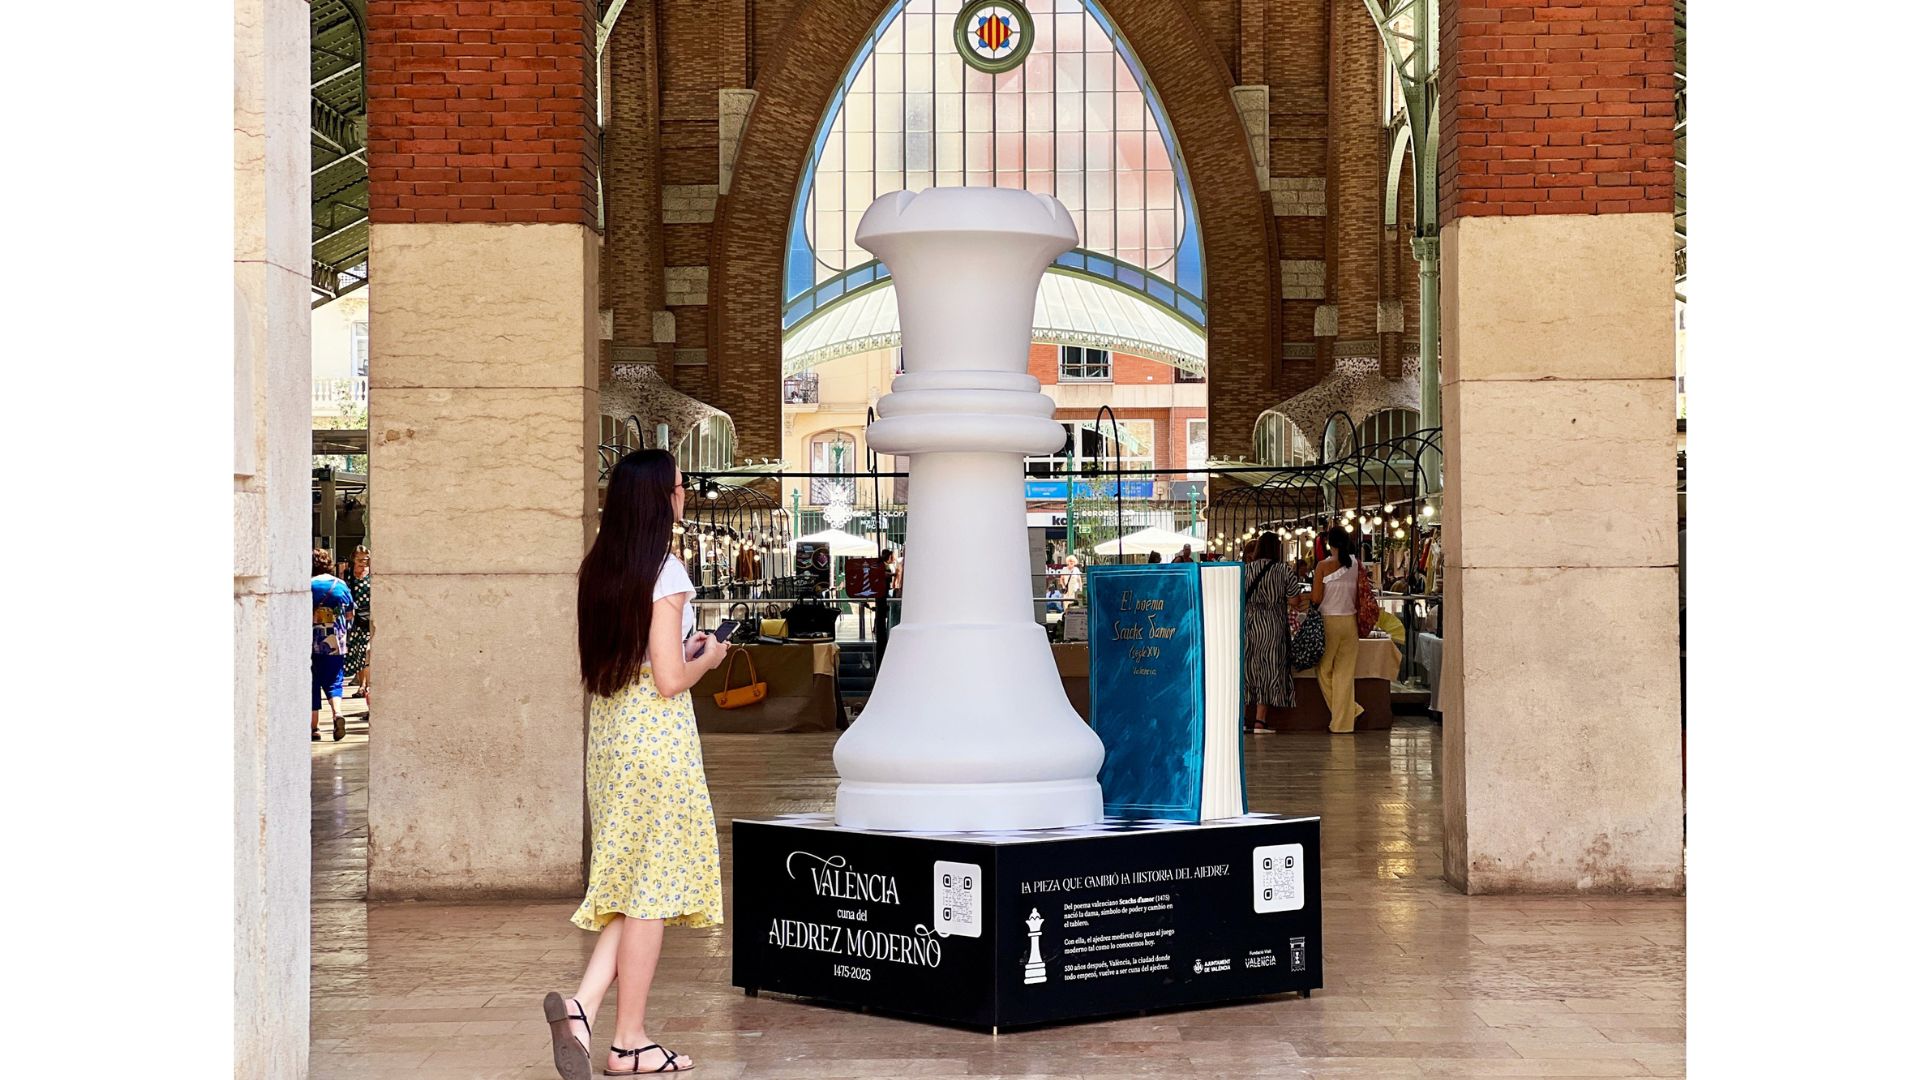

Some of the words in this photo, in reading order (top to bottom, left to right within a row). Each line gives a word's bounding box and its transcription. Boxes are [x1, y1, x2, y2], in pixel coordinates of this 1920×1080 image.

[1121, 591, 1132, 611] El
[1135, 599, 1164, 613] poema
[787, 851, 900, 904] VALÈNCIA
[1022, 882, 1031, 893] LA
[1034, 880, 1060, 892] PIEZA
[1063, 877, 1082, 891] QUE
[1122, 873, 1130, 884] LA
[1133, 869, 1173, 883] HISTORIA
[1176, 868, 1192, 879] DEL
[1194, 865, 1229, 878] AJEDREZ
[837, 909, 855, 919] cuna
[857, 909, 867, 921] del
[1074, 903, 1091, 912] poema
[1129, 906, 1143, 914] poder
[769, 919, 842, 953] AJEDREZ
[847, 924, 951, 968] MODERNO
[1093, 935, 1111, 944] ajedrez
[1112, 932, 1134, 940] medieval
[1161, 929, 1175, 937] juego
[1204, 959, 1230, 967] AJUNTAMENT
[834, 964, 871, 981] 1475-2025
